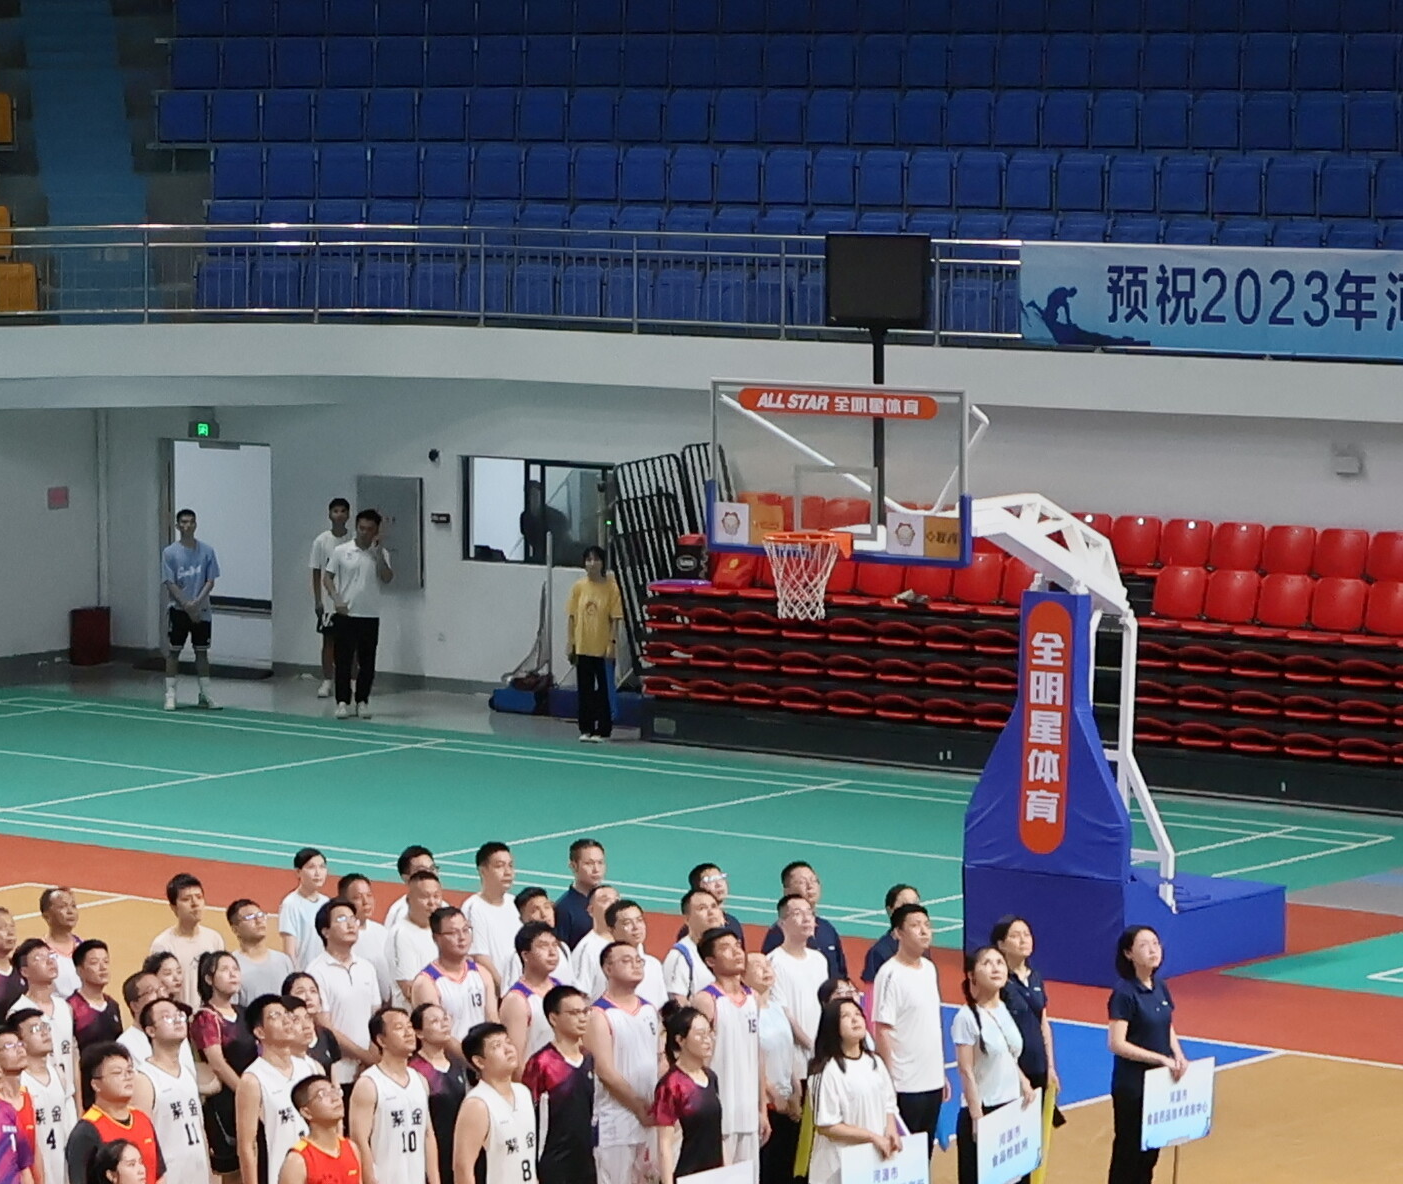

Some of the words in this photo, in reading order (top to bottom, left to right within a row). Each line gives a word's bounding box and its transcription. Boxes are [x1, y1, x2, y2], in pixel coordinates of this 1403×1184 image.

[756, 392, 786, 409] ALL
[787, 393, 830, 411] STAR
[834, 396, 919, 416] 全明星体育
[1024, 631, 1066, 824] 全明星体育
[390, 1107, 423, 1128] 紫金
[46, 1128, 57, 1150] 4
[402, 1130, 417, 1154] 10
[505, 1131, 535, 1155] 紫金
[521, 1159, 533, 1182] 8
